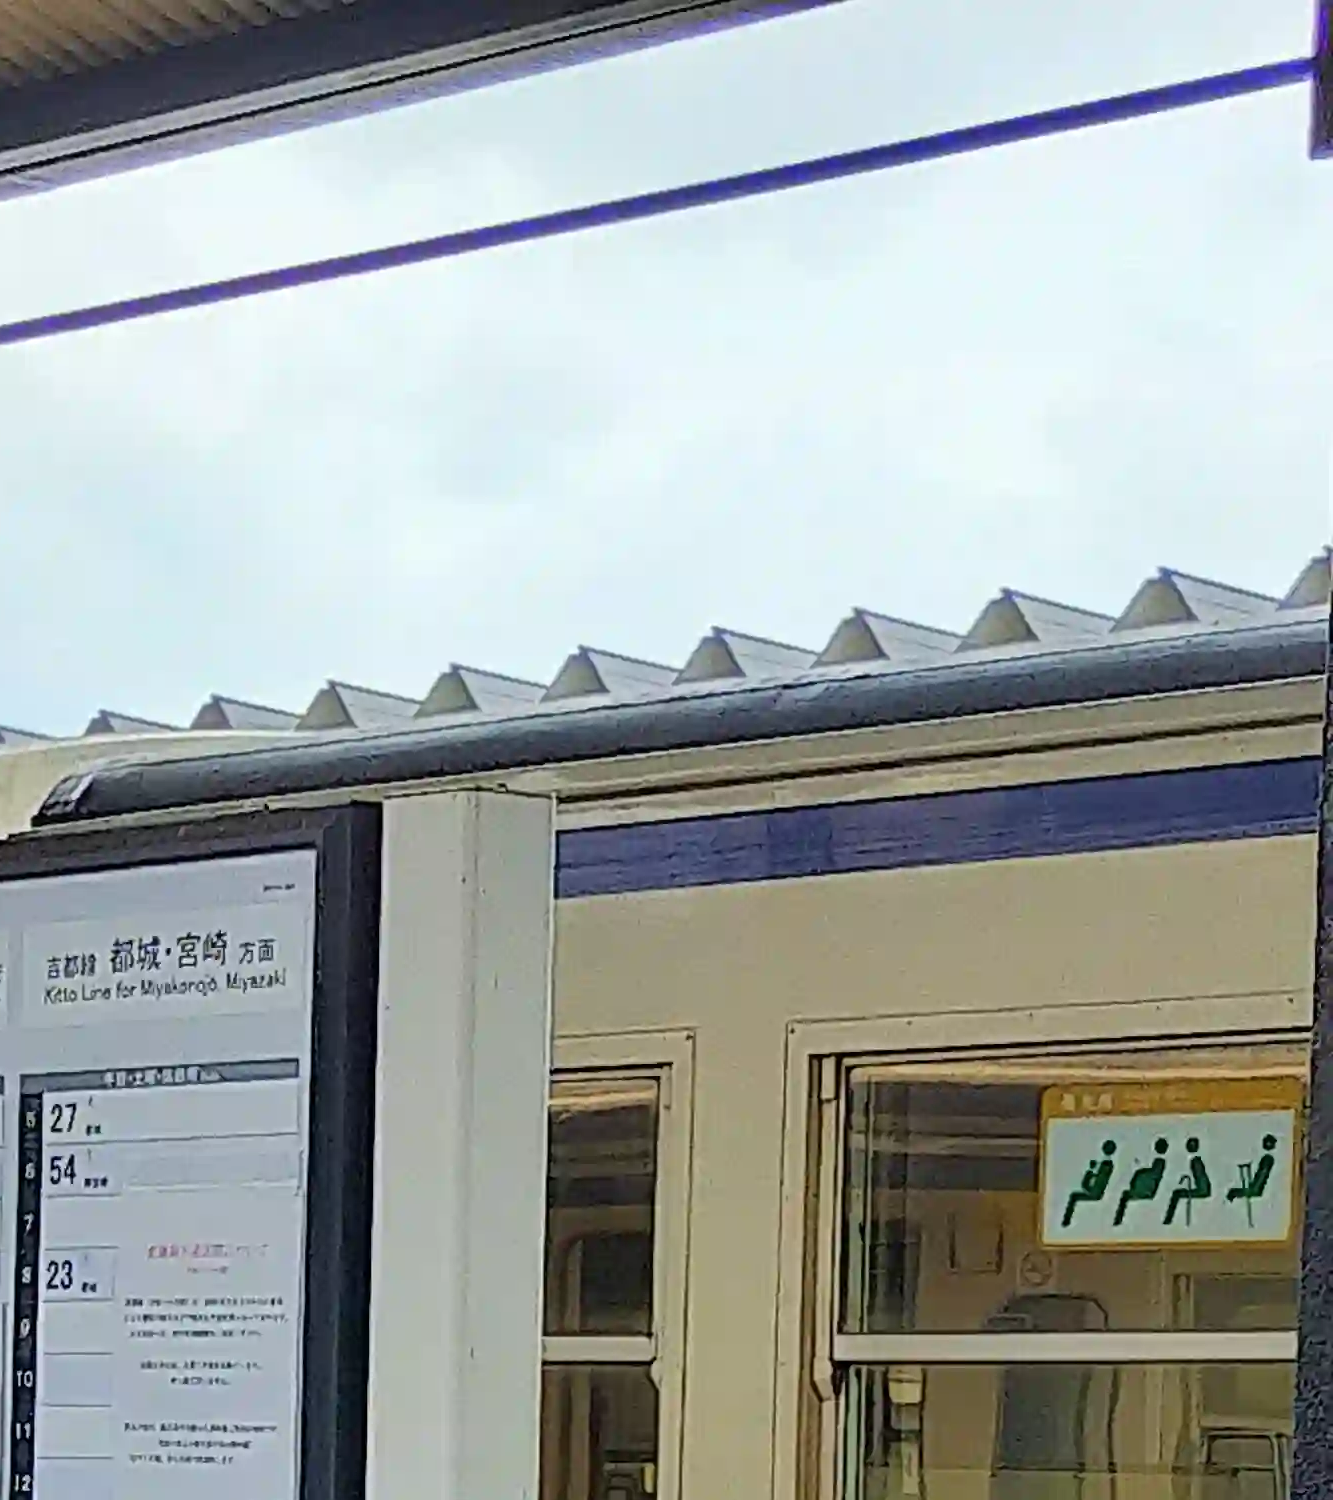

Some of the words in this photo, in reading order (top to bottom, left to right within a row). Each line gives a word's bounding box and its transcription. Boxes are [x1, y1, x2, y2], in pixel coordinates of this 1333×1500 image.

[110, 929, 228, 974] 都城・宮崎
[238, 938, 276, 965] 方面
[50, 1102, 78, 1133] 27
[50, 1154, 76, 1186] 54
[45, 1260, 74, 1290] 23
[16, 1370, 33, 1387] 10
[15, 1422, 31, 1440] 11
[14, 1474, 31, 1492] 12
